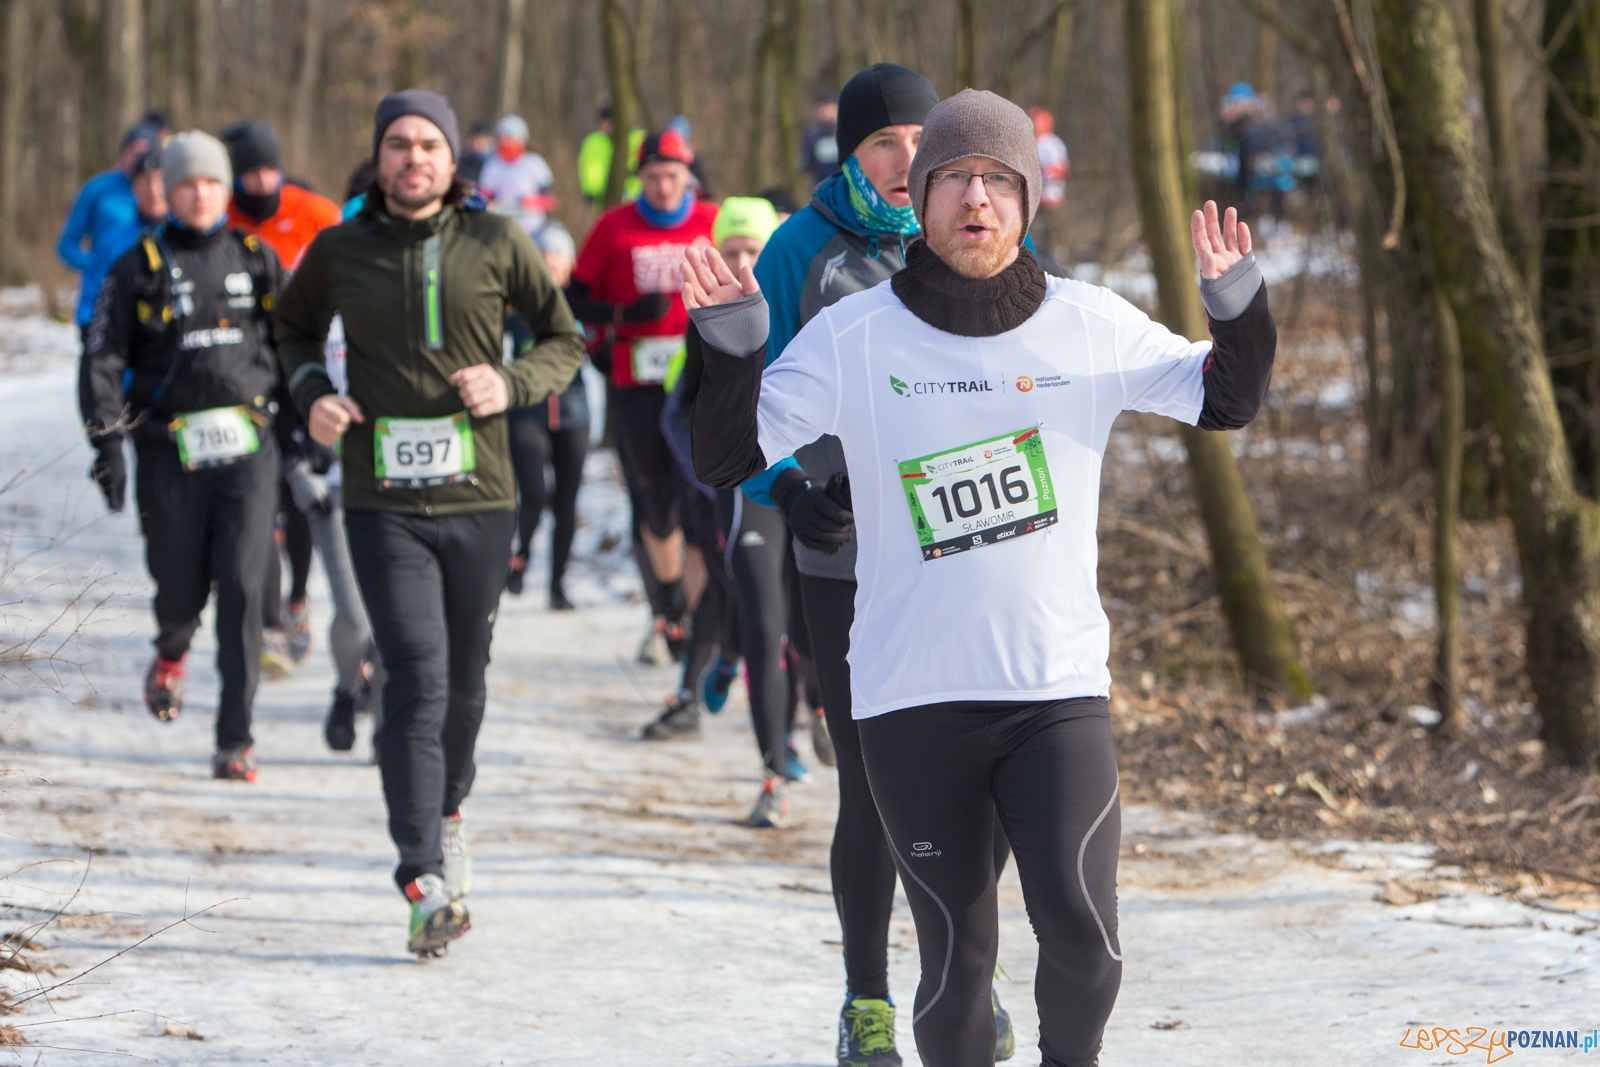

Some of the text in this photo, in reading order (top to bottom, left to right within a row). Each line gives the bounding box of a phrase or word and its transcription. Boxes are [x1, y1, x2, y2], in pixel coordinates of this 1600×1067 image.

[1035, 375, 1062, 383] nationale
[1036, 379, 1071, 389] nederlanden
[395, 437, 451, 466] 697
[932, 465, 1030, 523] 1016
[1038, 467, 1050, 500] Poznań
[962, 510, 1016, 533] SŁAWOMIR
